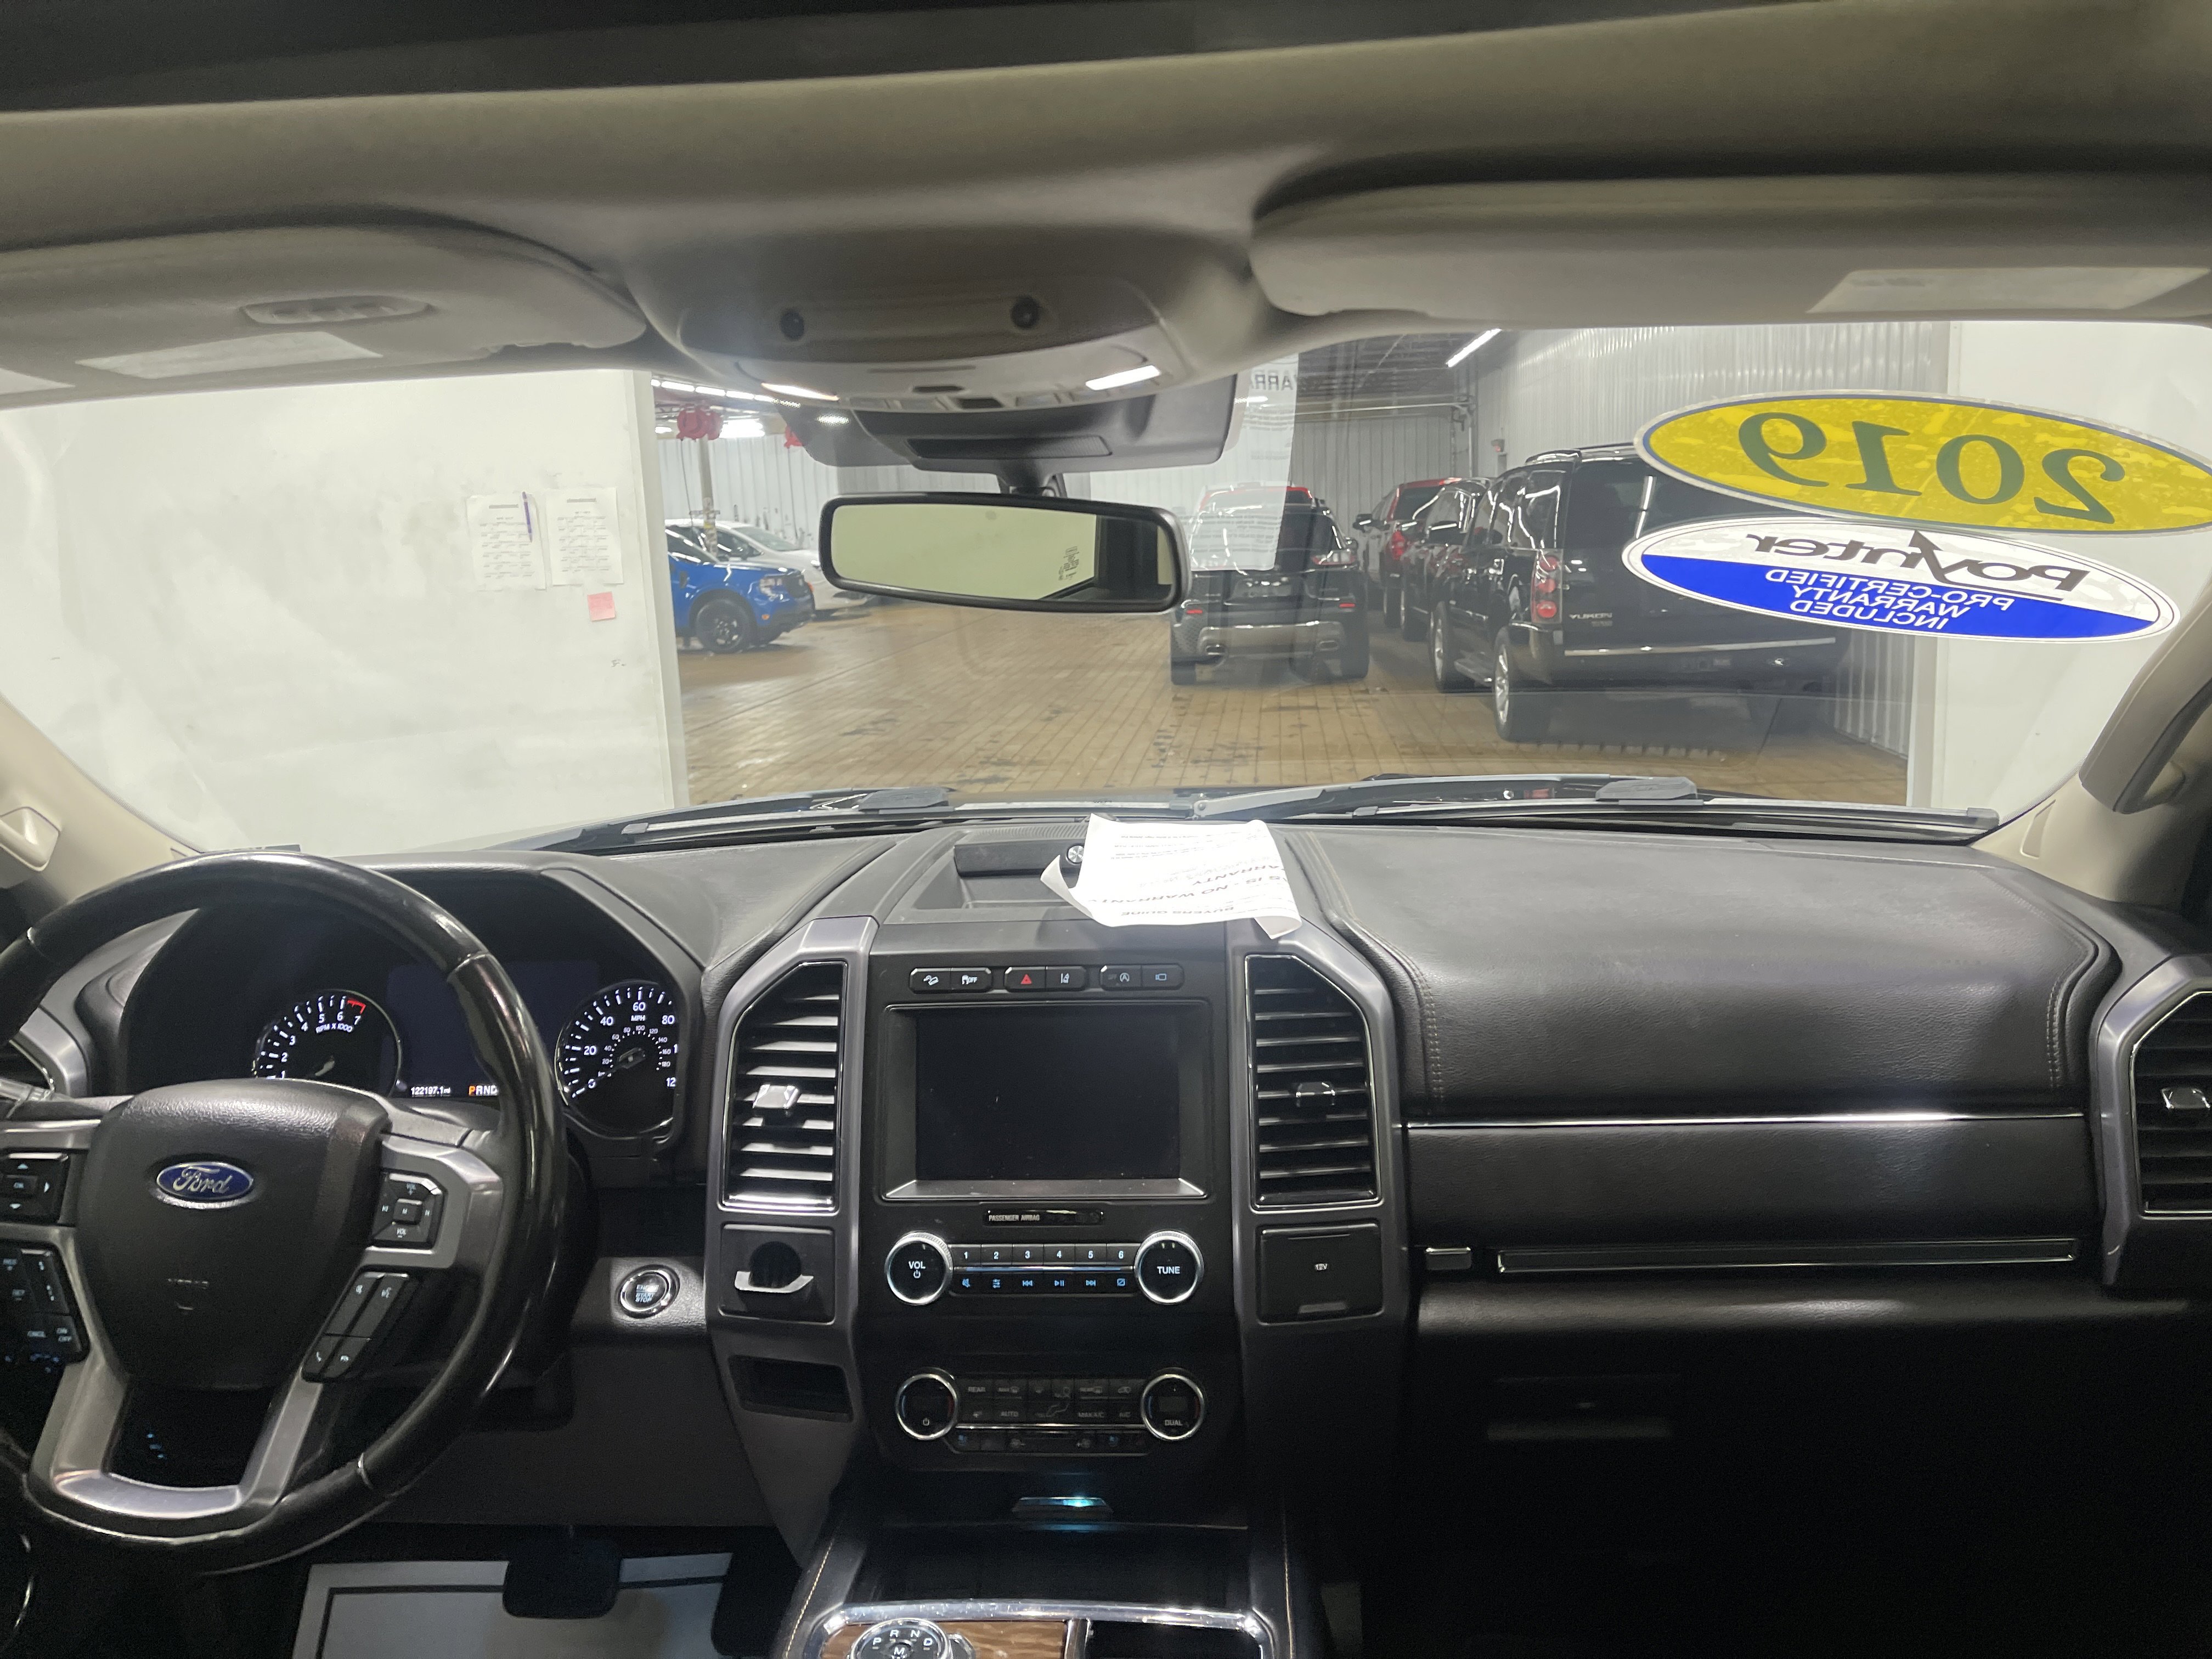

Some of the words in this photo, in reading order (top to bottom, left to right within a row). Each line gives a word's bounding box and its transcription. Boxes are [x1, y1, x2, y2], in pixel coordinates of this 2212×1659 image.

[1192, 865, 1285, 885] ARRANTY
[1201, 884, 1228, 895] NO
[633, 1002, 646, 1011] 60
[318, 1013, 325, 1023] 5
[337, 1011, 343, 1021] 6
[354, 1015, 362, 1025] 7
[662, 1015, 675, 1025] 80
[600, 1016, 613, 1026] 40
[301, 1022, 308, 1031] 4
[315, 1024, 330, 1033] RPM
[337, 1023, 354, 1032] 1000
[289, 1035, 296, 1045] 3
[584, 1046, 597, 1055] 20
[281, 1052, 288, 1062] 2
[172, 1165, 234, 1194] Ford
[963, 1251, 968, 1259] 1
[994, 1251, 999, 1259] 2
[1025, 1251, 1030, 1259] 3
[1057, 1251, 1062, 1259] 4
[1088, 1251, 1093, 1259] 5
[1118, 1251, 1124, 1259] 6
[908, 1261, 926, 1270] VOL
[1157, 1266, 1181, 1274] TUNE
[889, 1629, 899, 1638] R
[910, 1629, 920, 1638] N
[872, 1637, 882, 1645] P
[923, 1638, 933, 1646] D
[894, 1647, 905, 1655] M
